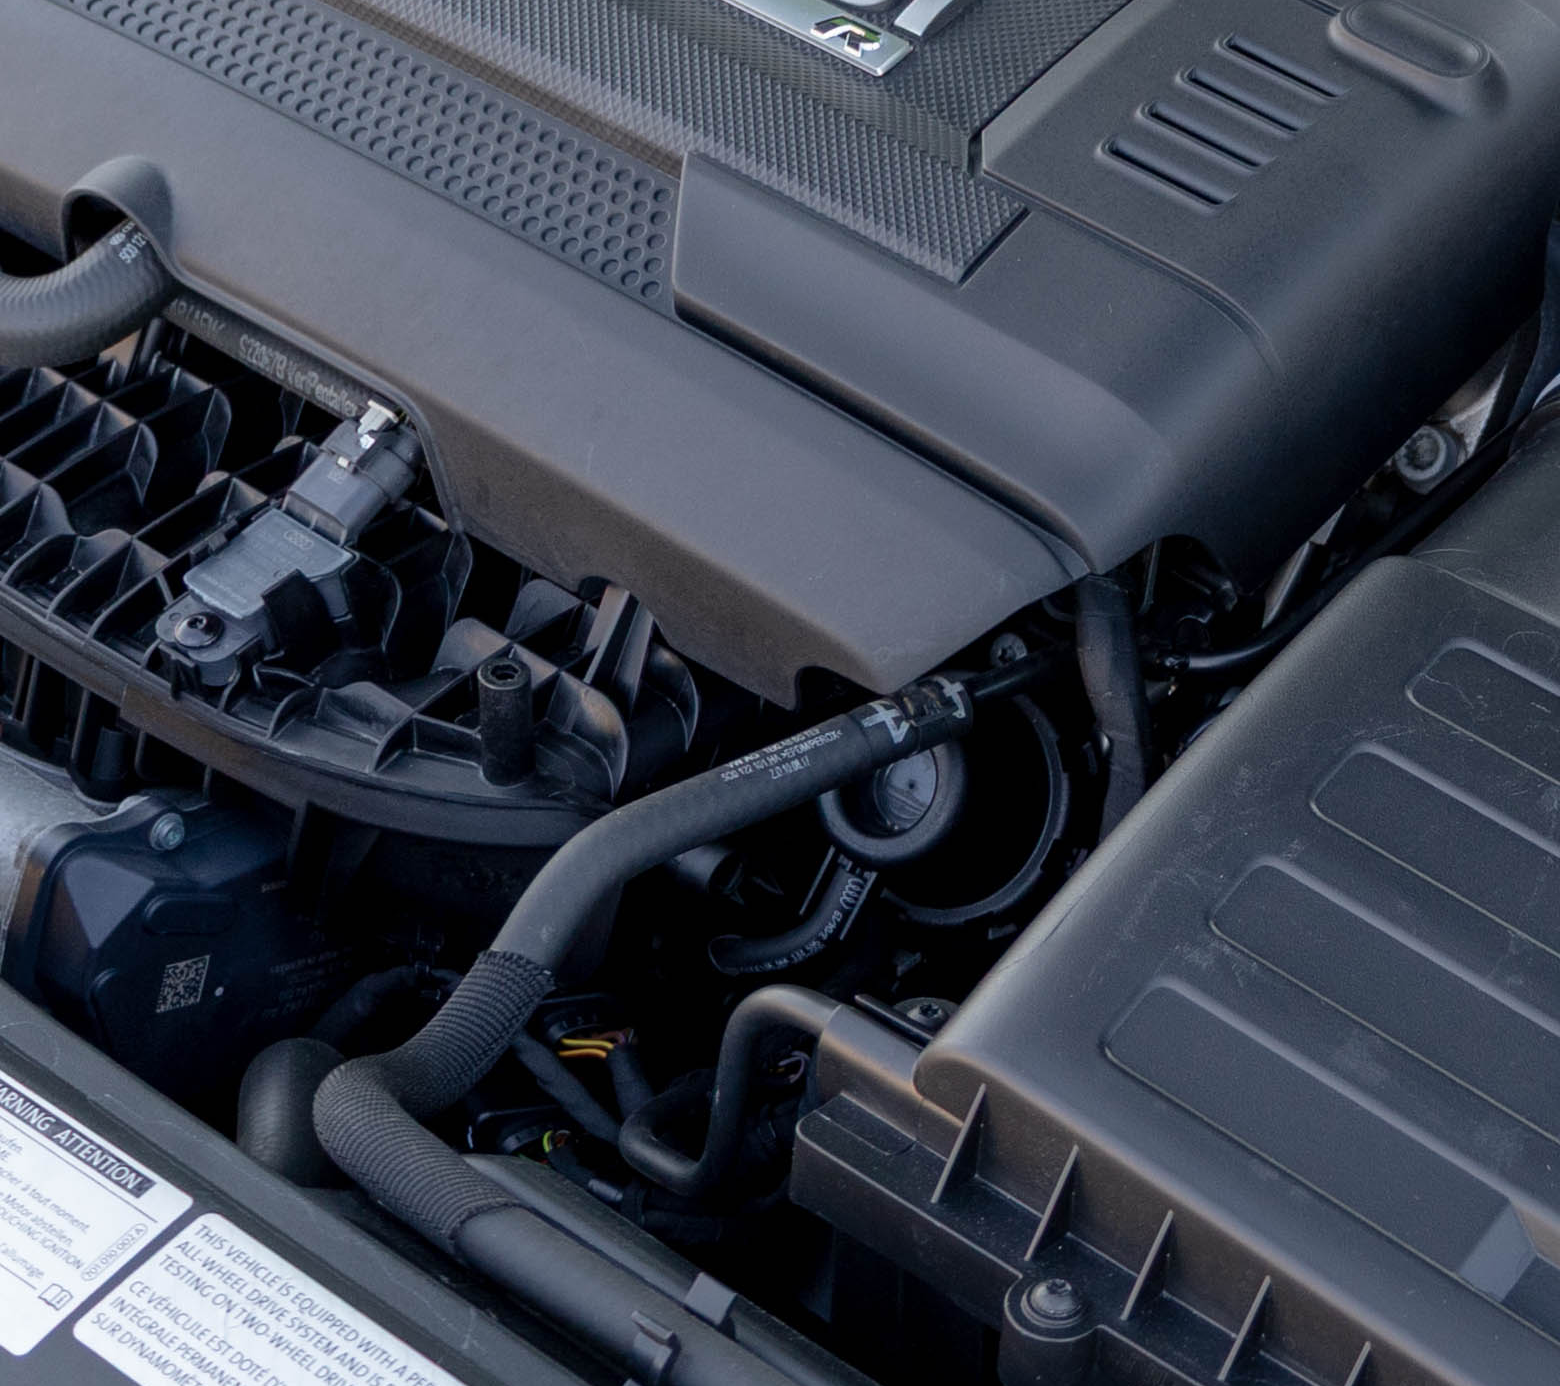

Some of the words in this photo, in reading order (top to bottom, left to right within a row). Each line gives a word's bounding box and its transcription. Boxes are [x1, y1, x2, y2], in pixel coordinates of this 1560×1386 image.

[810, 17, 882, 58] R
[52, 1128, 142, 1189] ATTENTION
[127, 1279, 152, 1299] CE
[145, 1290, 211, 1341] VÉHICULE
[204, 1333, 234, 1356] EST
[227, 1349, 270, 1382] DOTÉ
[158, 1253, 216, 1298] TESTING
[210, 1292, 238, 1314] ON
[234, 1307, 316, 1371] TWO-WHEEL
[174, 1240, 248, 1294] ALL-WHEEL
[244, 1287, 289, 1322] DRIVE
[284, 1315, 339, 1356] SYSTEM
[333, 1351, 370, 1378] AND
[193, 1224, 228, 1251] THIS
[223, 1244, 282, 1288] VEHICLE
[275, 1281, 295, 1297] IS
[289, 1291, 360, 1343] EQUIPPED
[355, 1337, 398, 1369] WITH
[391, 1363, 409, 1378] A
